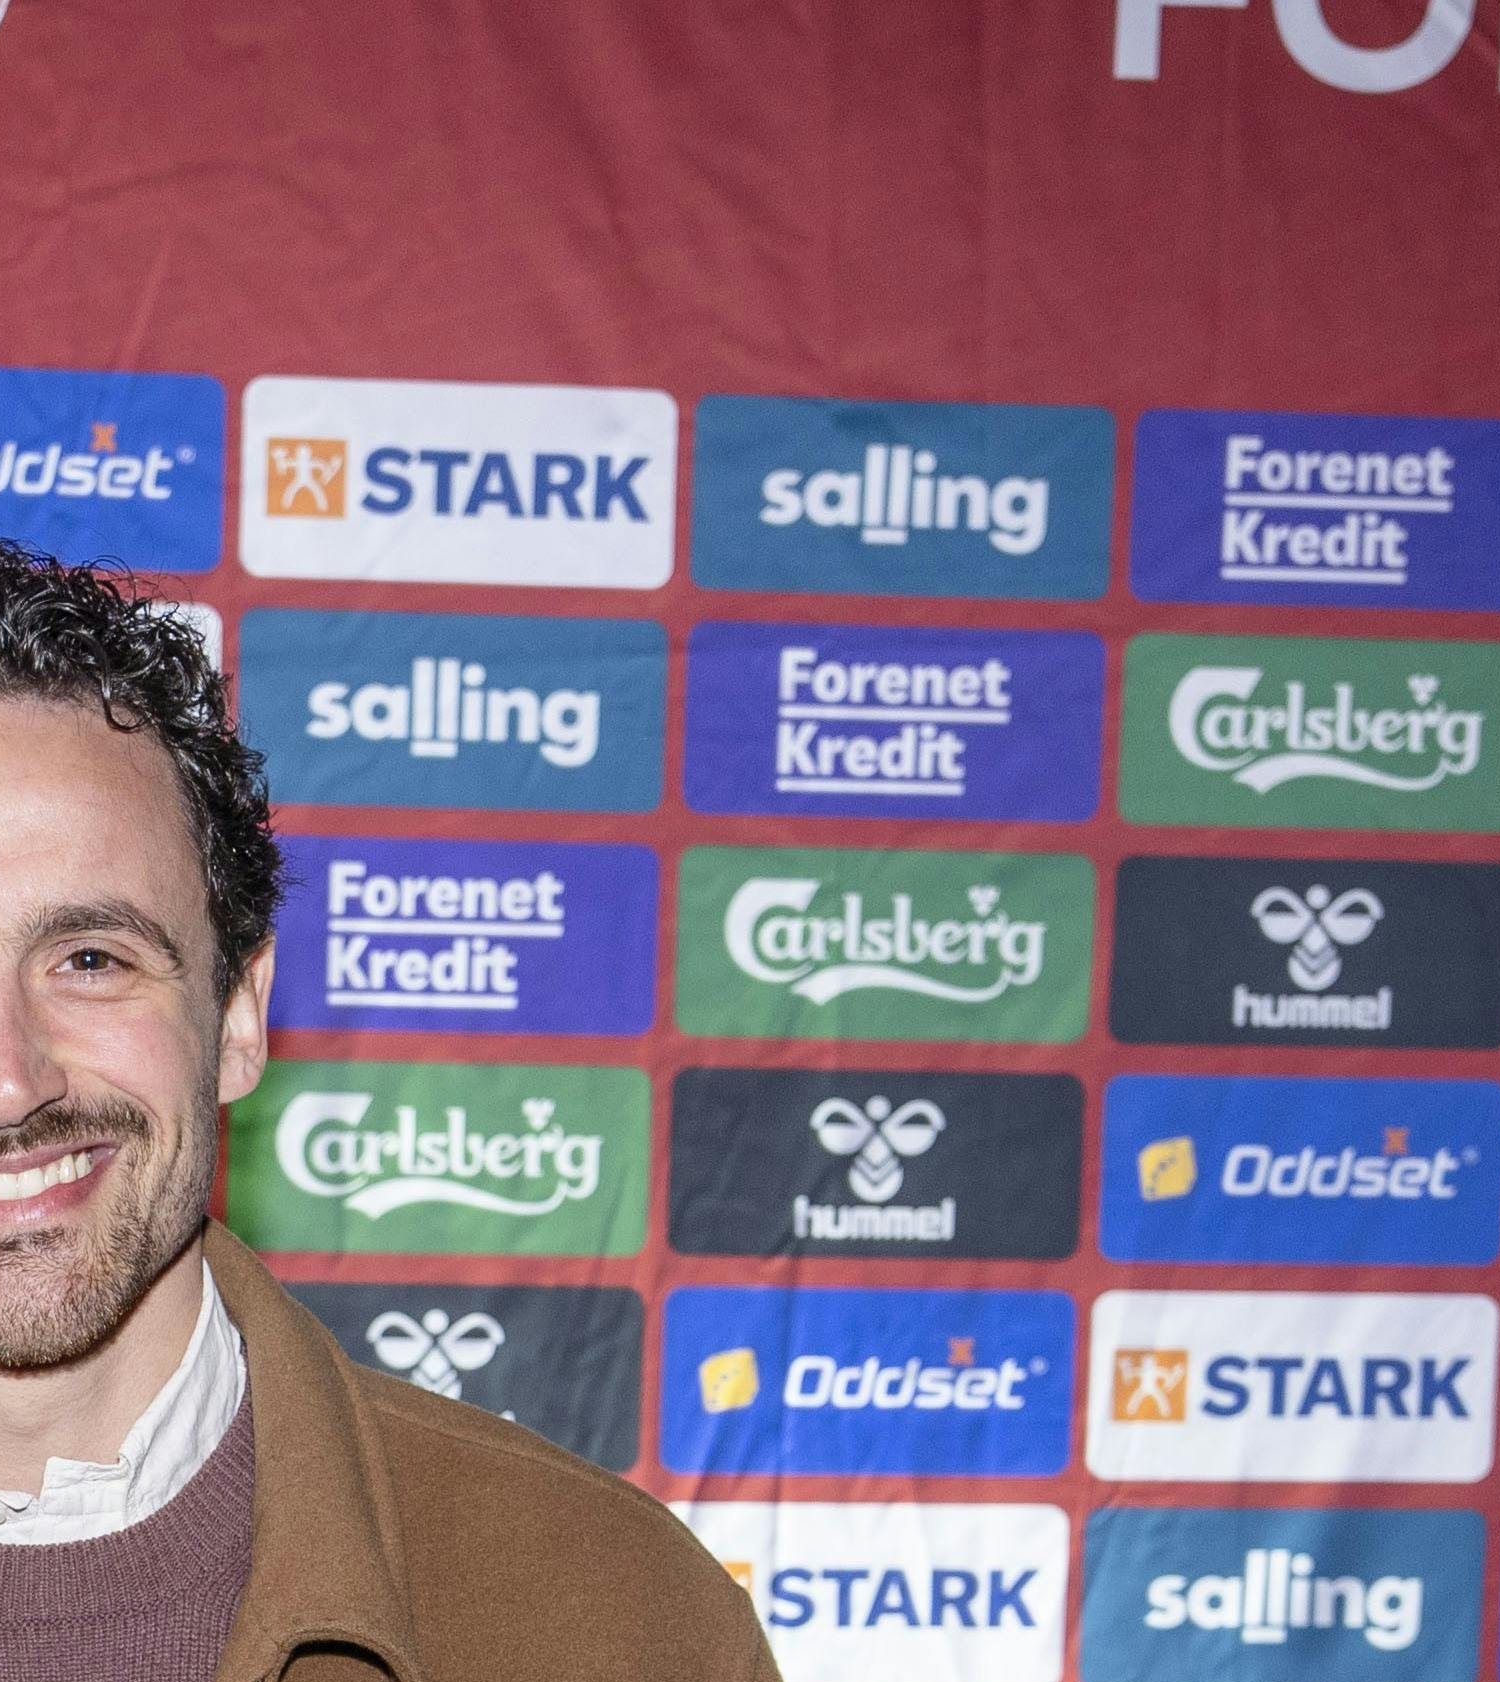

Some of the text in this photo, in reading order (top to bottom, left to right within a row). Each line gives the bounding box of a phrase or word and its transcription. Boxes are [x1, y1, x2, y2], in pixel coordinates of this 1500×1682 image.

[360, 445, 649, 523] STARK
[1225, 436, 1452, 496] Forenet
[760, 444, 1049, 555] salling
[1221, 510, 1406, 568] Kredit
[779, 647, 1009, 707] Forenet
[306, 657, 600, 768] salling
[1168, 666, 1482, 794] Carlsberg
[776, 721, 964, 780] Kredit
[329, 861, 563, 921] Forenet
[327, 935, 517, 994] Kredit
[724, 878, 1045, 1006] Carlsberg
[1232, 985, 1392, 1030] hummel
[275, 1091, 602, 1220] Carlsberg
[793, 1195, 956, 1241] hummel
[1201, 1354, 1471, 1420] STARK
[766, 1566, 1037, 1630] STARK
[1144, 1548, 1422, 1651] salling
